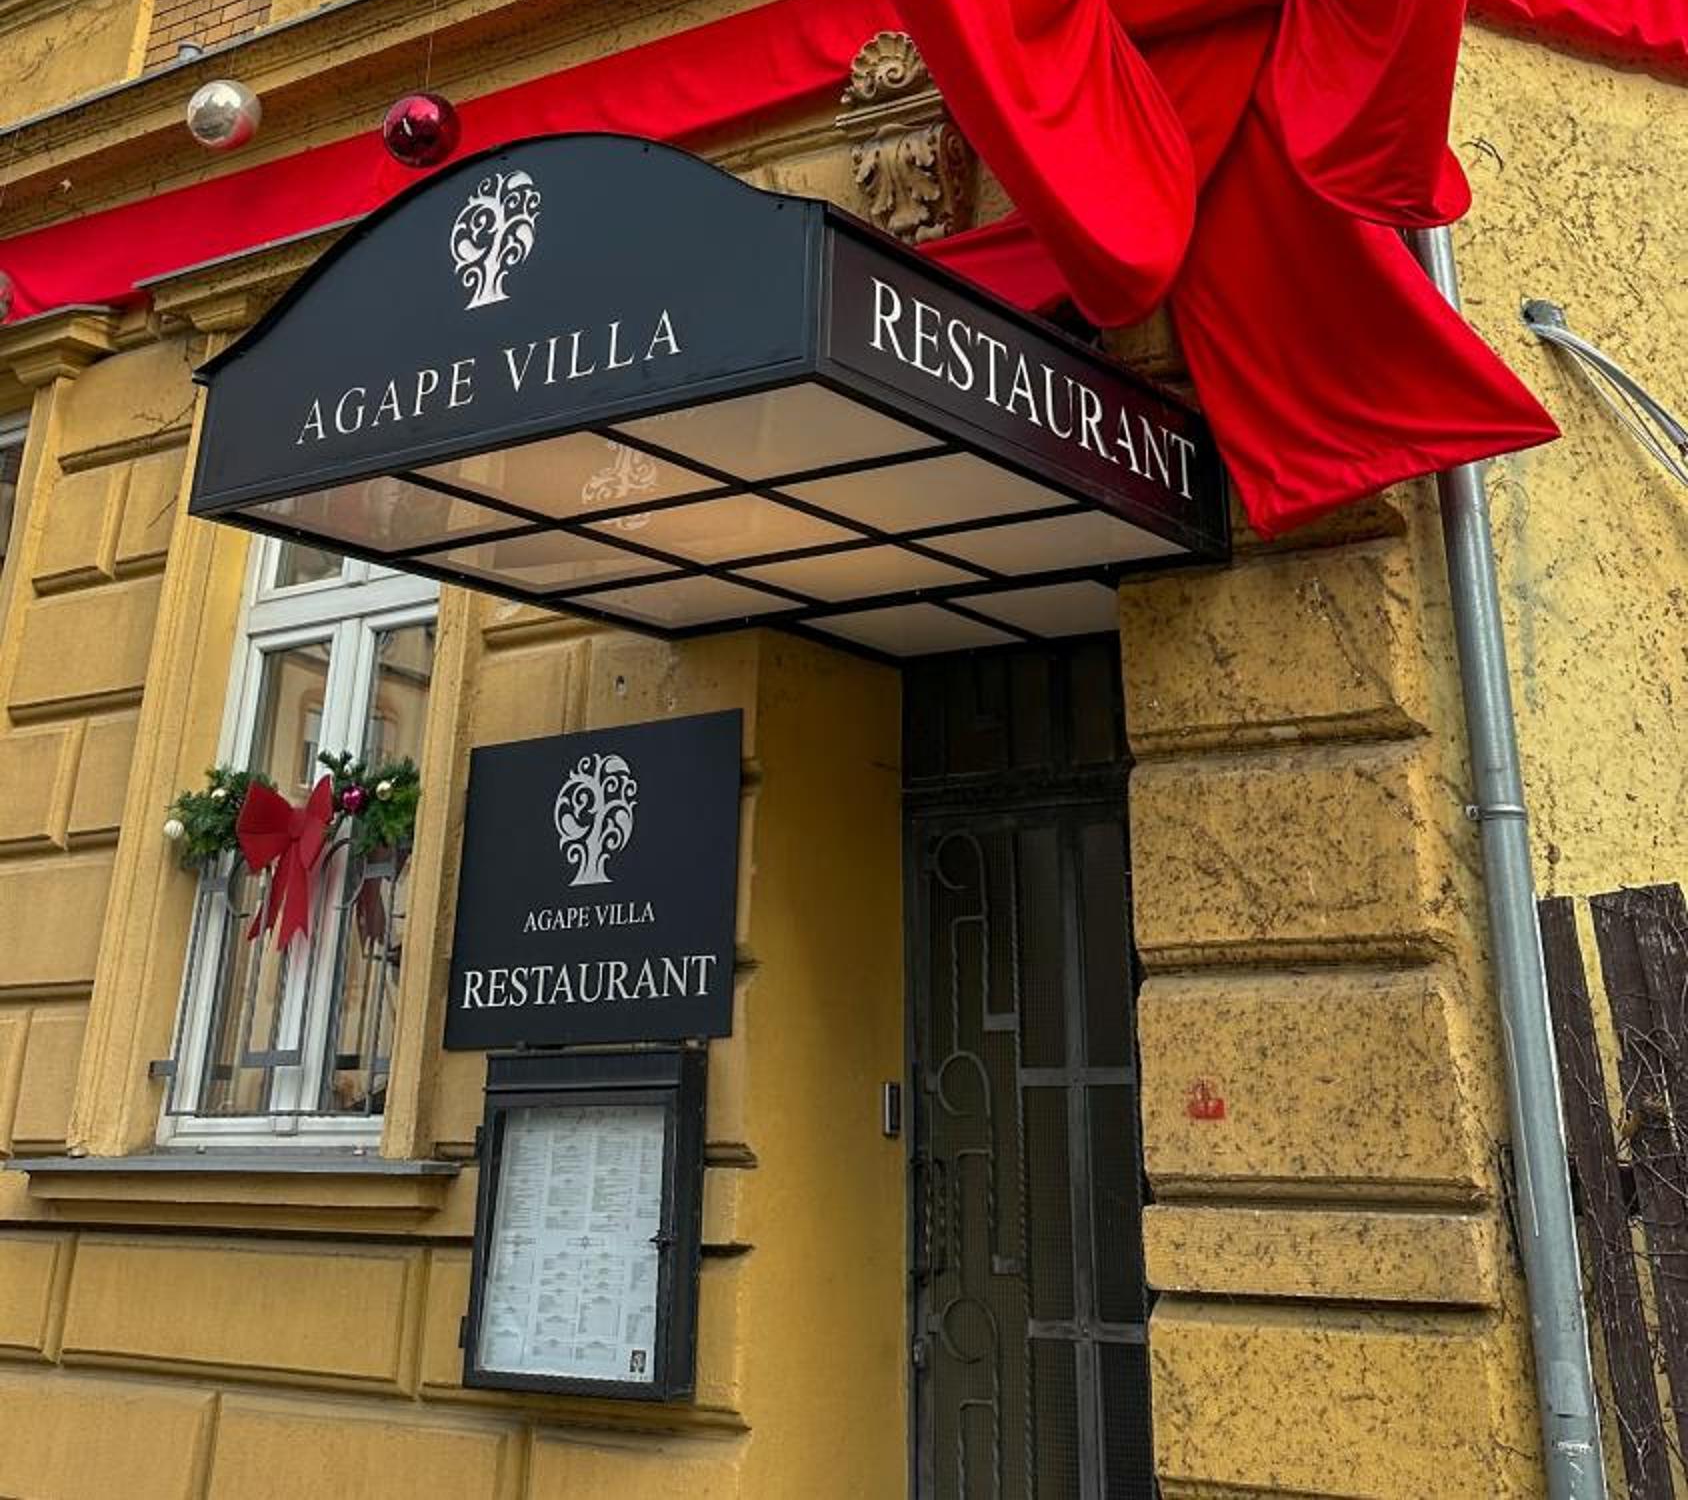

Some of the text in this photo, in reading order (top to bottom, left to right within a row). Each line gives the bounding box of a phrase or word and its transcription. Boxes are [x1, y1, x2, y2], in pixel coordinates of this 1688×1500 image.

[296, 308, 682, 444] AGAPE VILLA
[868, 275, 1196, 501] RESTAURANT
[523, 901, 655, 932] AGAPE VILLA
[460, 954, 716, 1009] RESTAURANT
